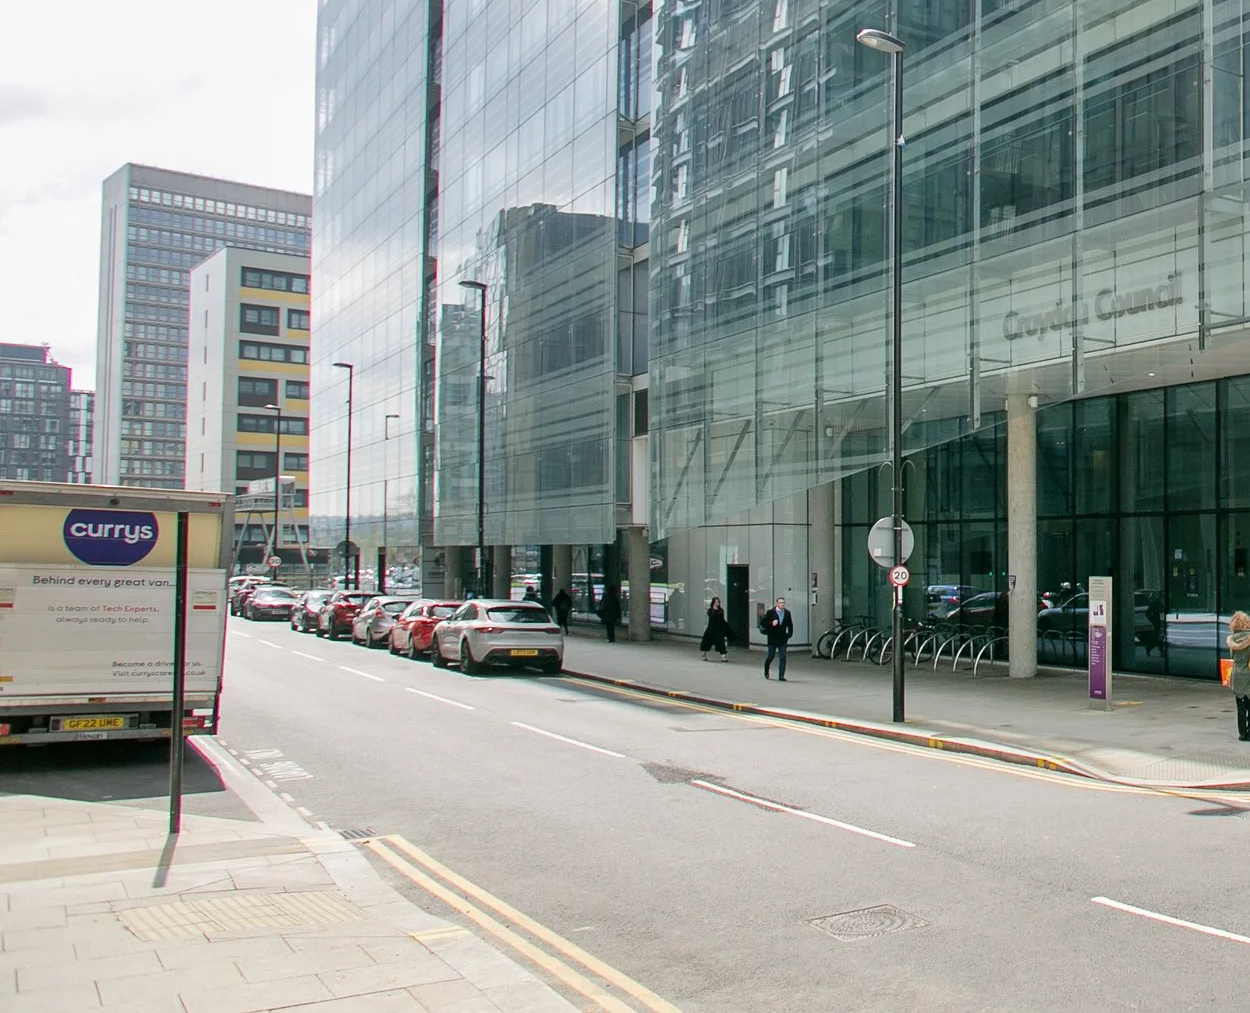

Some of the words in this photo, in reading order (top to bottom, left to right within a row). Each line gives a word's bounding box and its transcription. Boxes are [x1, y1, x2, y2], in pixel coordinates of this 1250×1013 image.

[1003, 302, 1089, 342] Croydon
[1094, 271, 1184, 321] Council
[70, 522, 154, 544] currys
[894, 571, 907, 580] 20
[32, 575, 75, 585] Behind
[78, 578, 111, 588] every
[114, 578, 145, 588] great
[102, 605, 123, 613] Tech
[56, 616, 88, 624] always
[89, 616, 117, 624] ready
